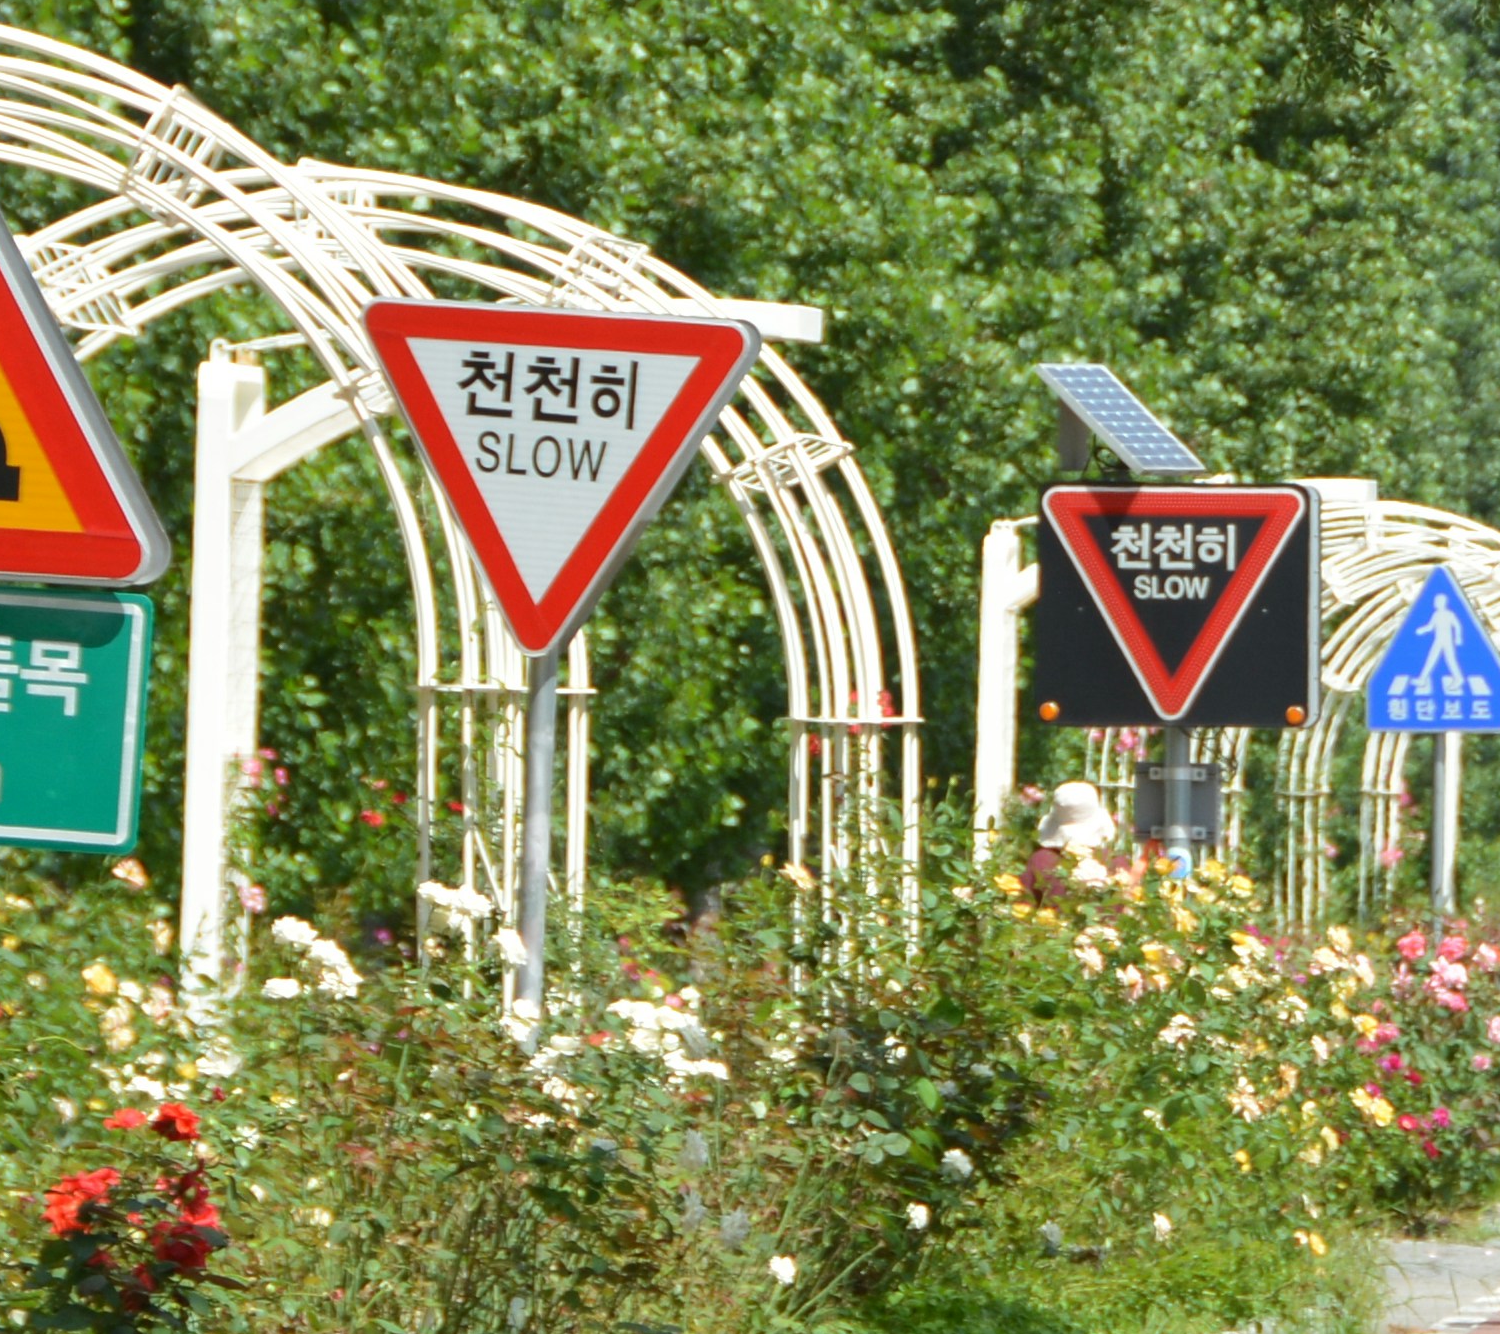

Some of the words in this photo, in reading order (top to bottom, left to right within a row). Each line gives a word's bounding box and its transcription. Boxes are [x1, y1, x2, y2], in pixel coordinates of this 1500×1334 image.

[457, 349, 640, 431] 천천히
[475, 430, 607, 483] SLOW
[1109, 522, 1237, 571] 천천히
[1133, 576, 1210, 601] SLOW
[1387, 698, 1493, 722] 횡단보도
